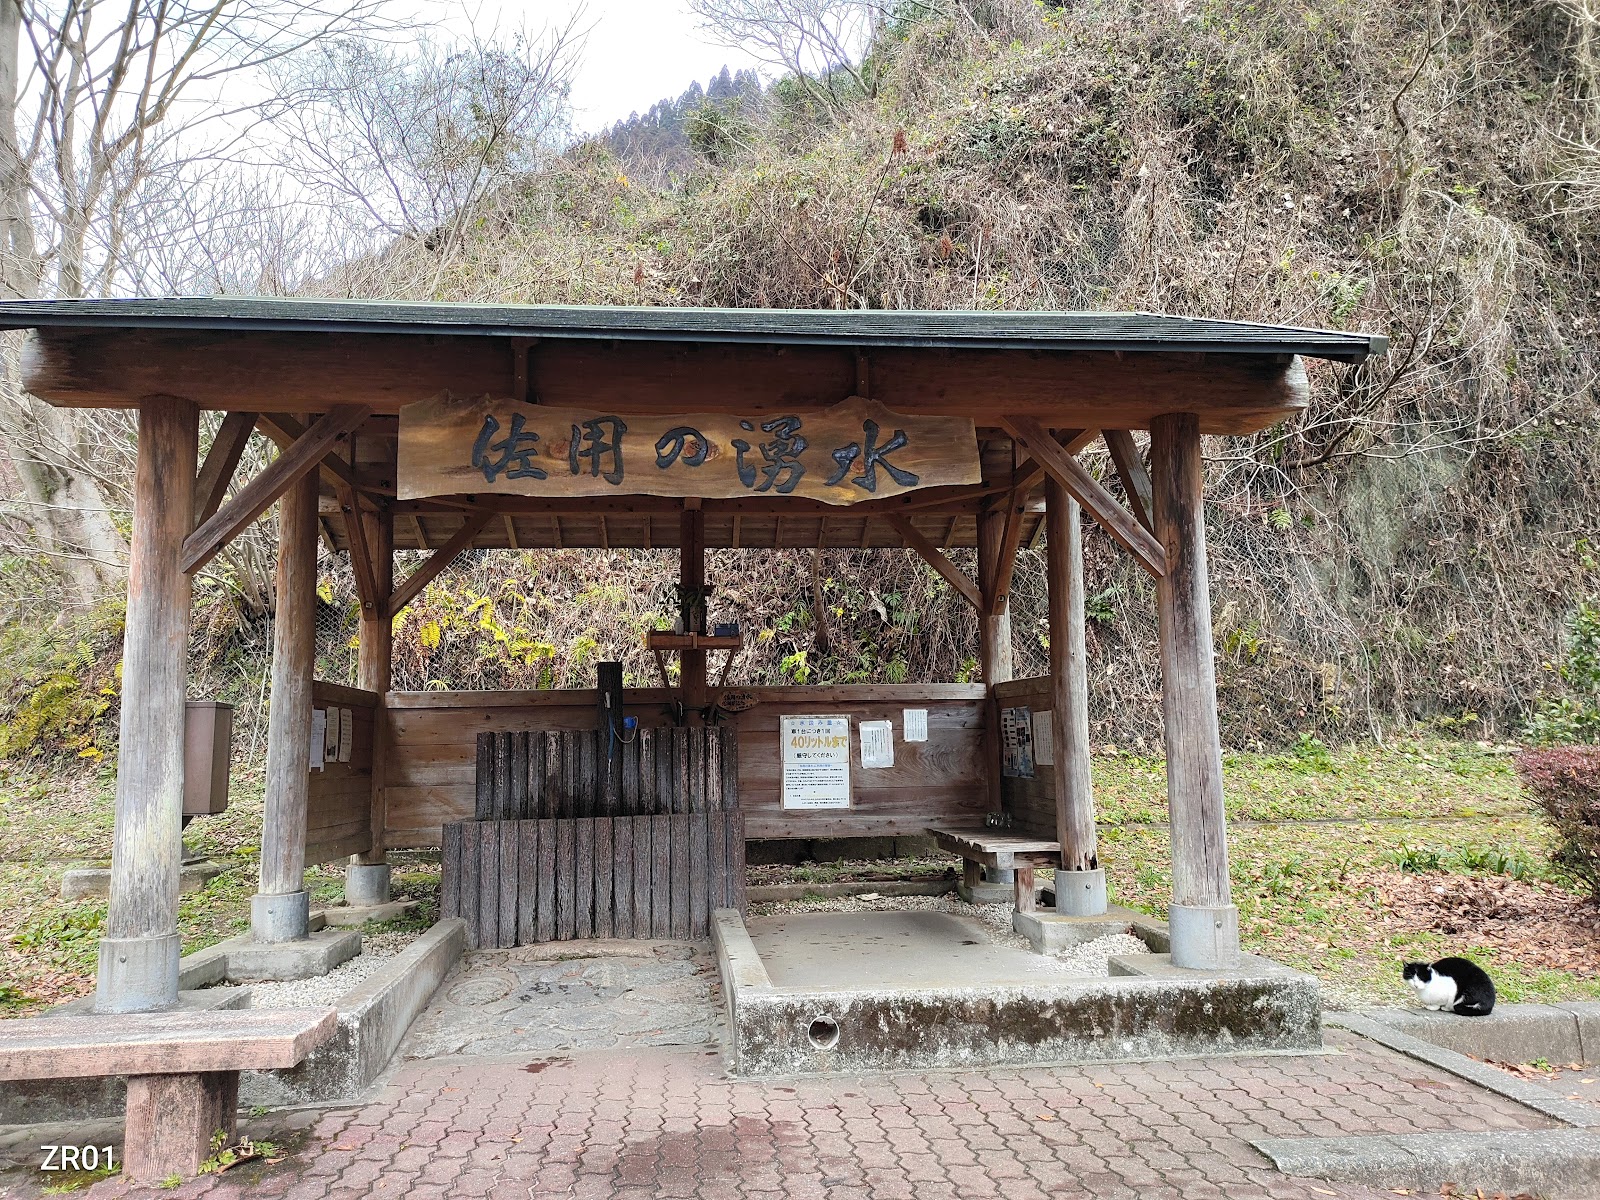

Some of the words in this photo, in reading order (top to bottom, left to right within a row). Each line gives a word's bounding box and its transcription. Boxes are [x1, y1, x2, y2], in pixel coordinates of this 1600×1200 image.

[471, 413, 920, 493] 佐用の湧水
[791, 735, 848, 749] 40リットルまで
